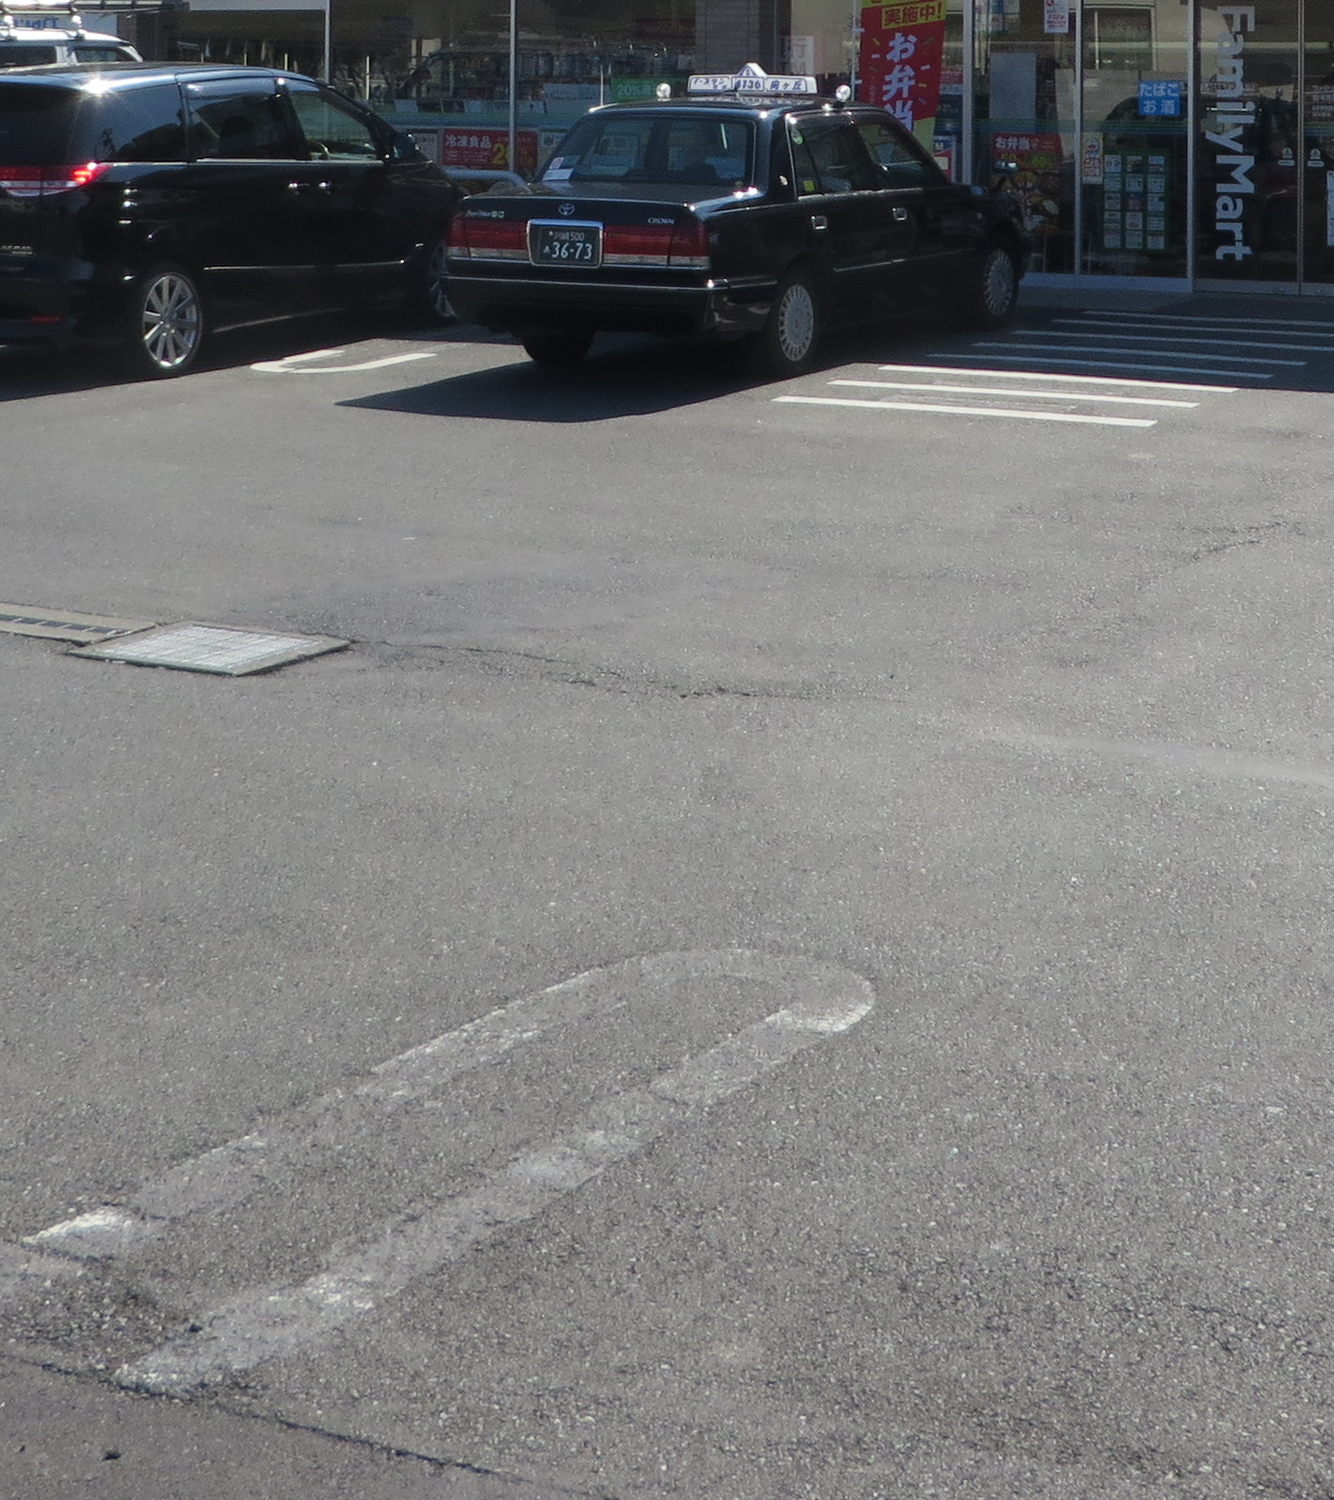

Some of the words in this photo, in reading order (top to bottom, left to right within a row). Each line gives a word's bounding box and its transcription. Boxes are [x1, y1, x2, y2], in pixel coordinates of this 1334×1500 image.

[883, 1, 943, 26] 実施中!
[1139, 83, 1180, 98] たばこ
[1143, 100, 1176, 115] お酒
[445, 133, 492, 149] 冷凍食品
[1205, 5, 1256, 261] FamilyMart
